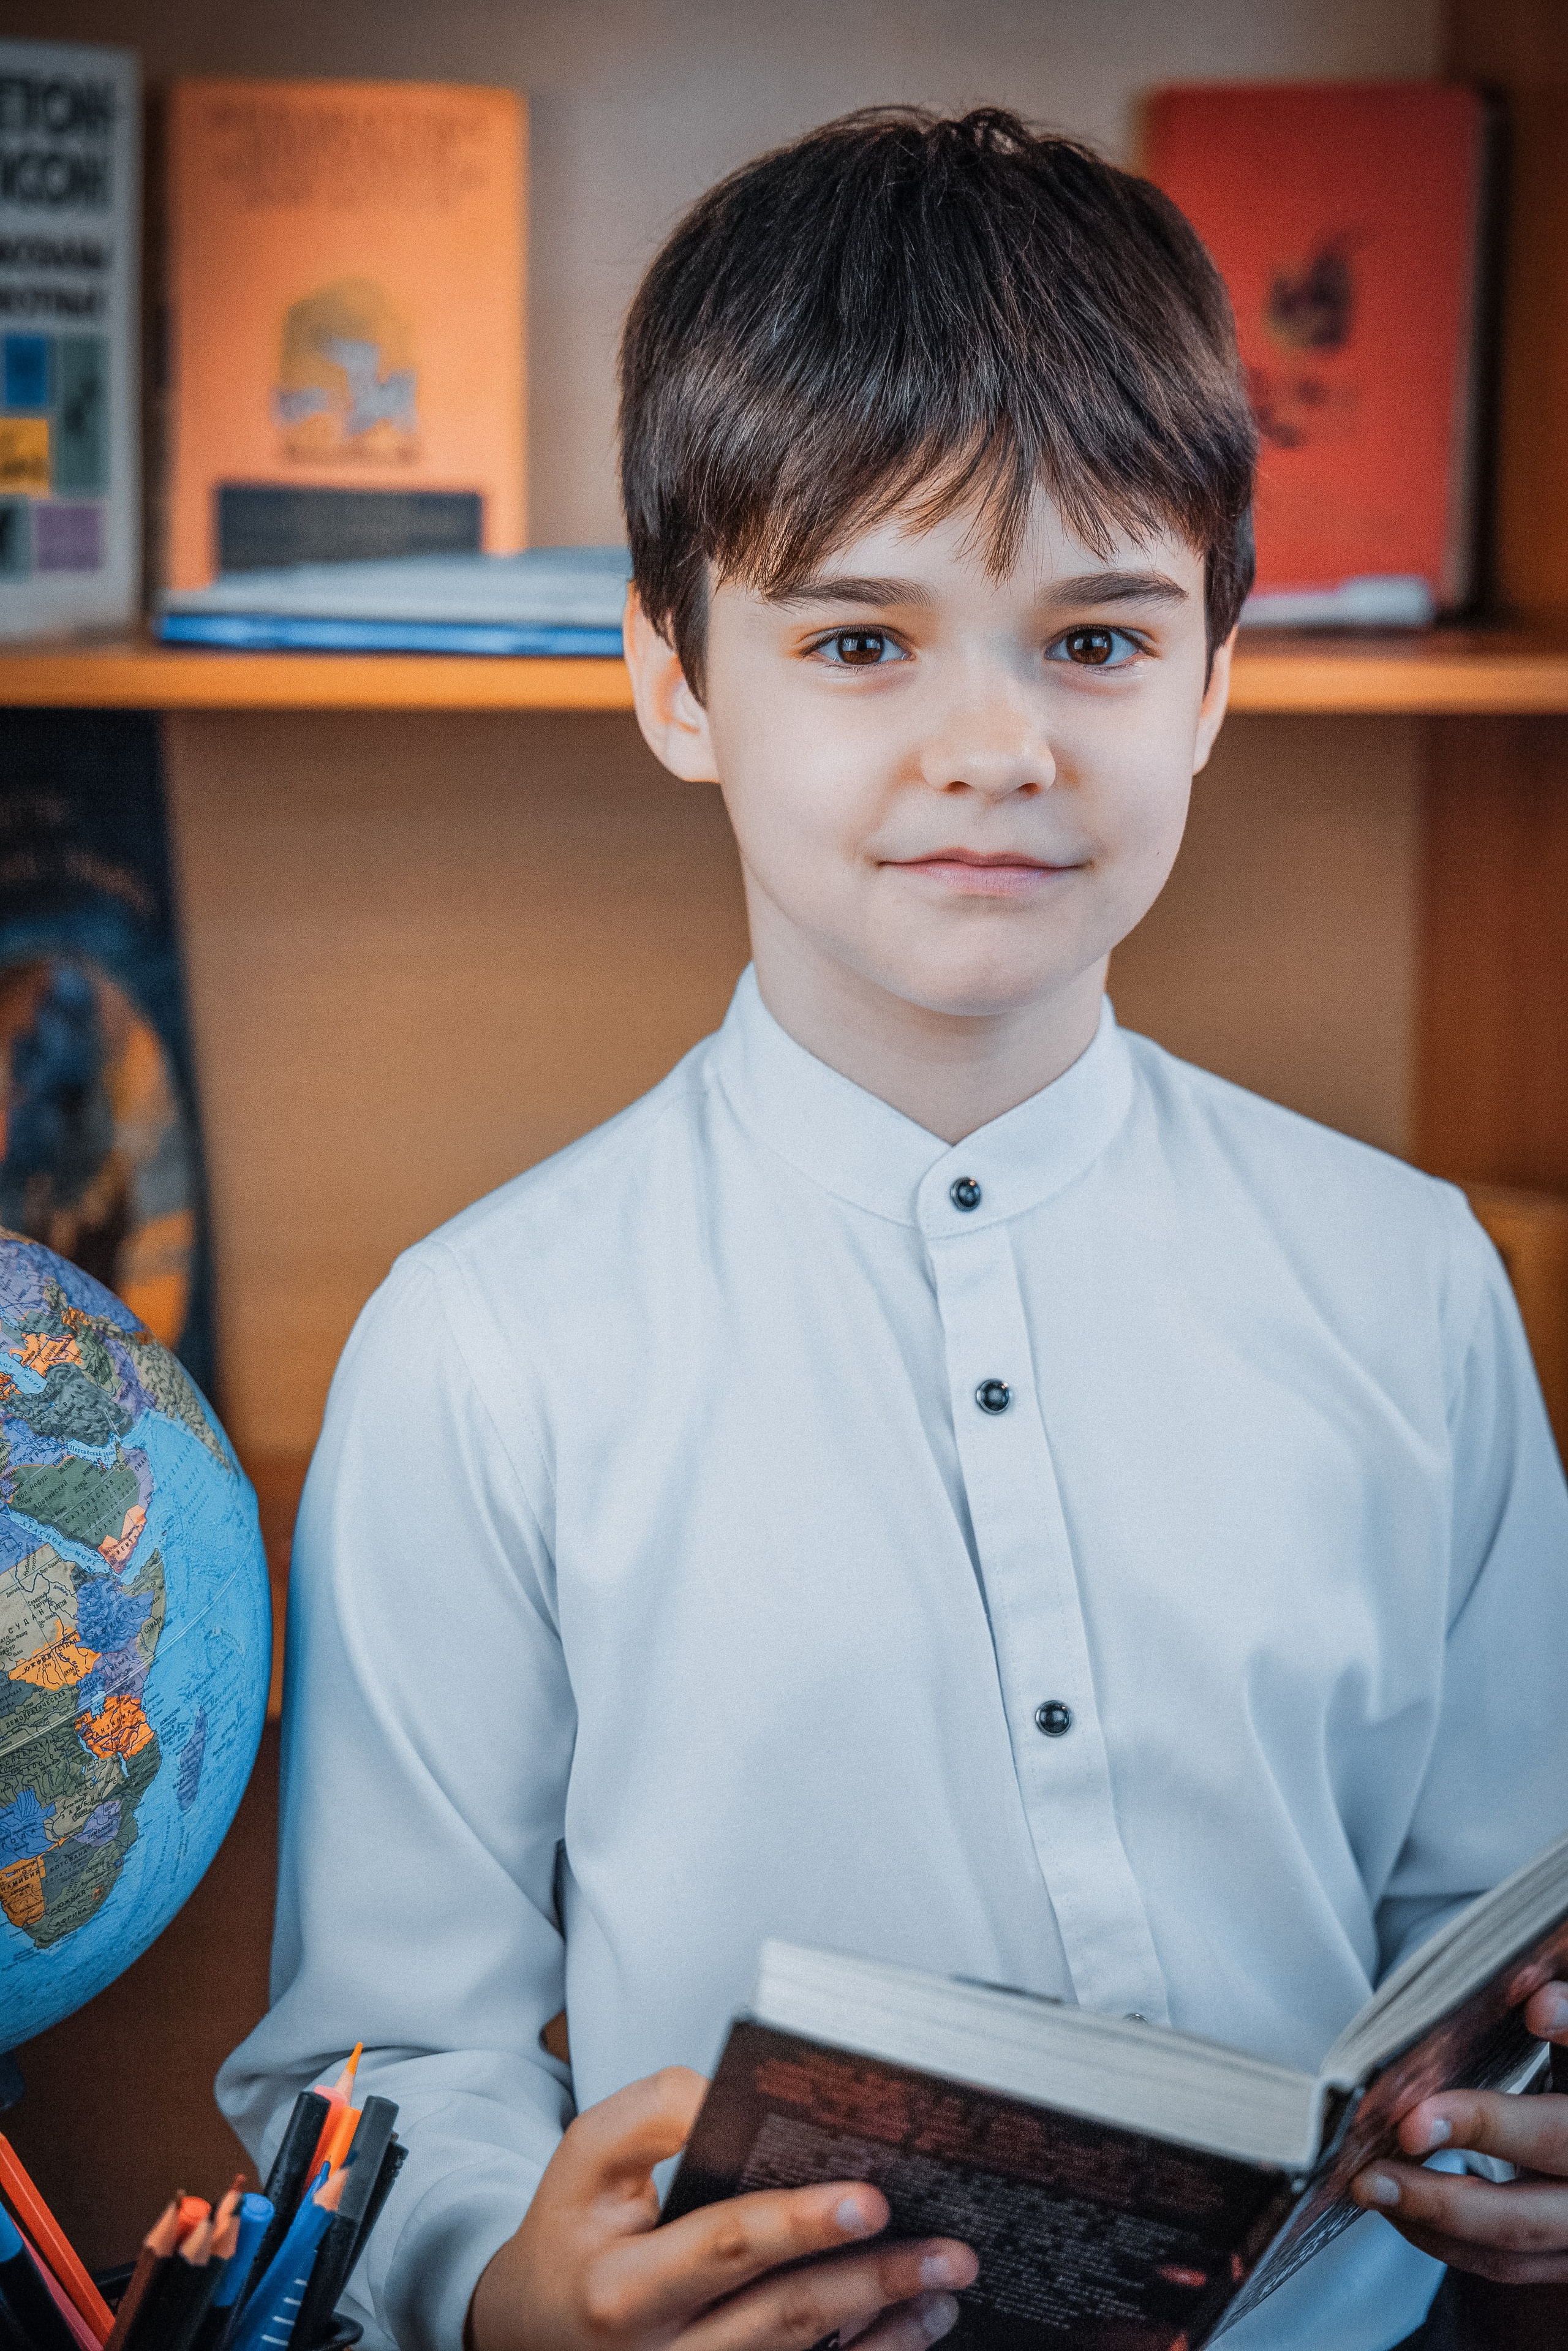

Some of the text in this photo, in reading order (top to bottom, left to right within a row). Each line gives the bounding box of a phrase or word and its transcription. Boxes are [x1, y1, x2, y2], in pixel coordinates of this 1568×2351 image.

[23, 1374, 42, 1389] МОРЕ
[55, 1384, 83, 1416] ИРАН
[29, 1442, 52, 1463] ИРАК
[69, 1444, 102, 1456] Персидский
[135, 1455, 148, 1471] ОМАН
[16, 1474, 48, 1501] Бол. Нефуд
[34, 1479, 69, 1511] Аравийский
[65, 1479, 115, 1524] САУДОВСКАЯ
[94, 1511, 122, 1536] АРАВИЯ
[22, 1521, 96, 1566] КРАСНОЕ МОРЕ
[116, 1535, 138, 1555] ЙЕМЕН
[27, 1591, 48, 1606] Северный
[32, 1599, 48, 1609] Хартум
[8, 1609, 44, 1634] СУДАН
[144, 1615, 163, 1634] СОМАЛИ
[58, 1637, 77, 1651] СУДАН
[6, 1690, 66, 1729] ДЕМОКРАТИЧЕСКАЯ
[27, 1755, 53, 1772] КОНГО
[61, 1793, 102, 1819] ЗАМБИЯ
[87, 1820, 115, 1840] ЗИМБАБВЕ
[50, 1849, 88, 1872] БОТСВАНА
[1, 1870, 40, 1892] НАМИБИЯ
[57, 1890, 86, 1908] ЮЖНАЯ
[56, 1907, 87, 1927] АФРИКА
